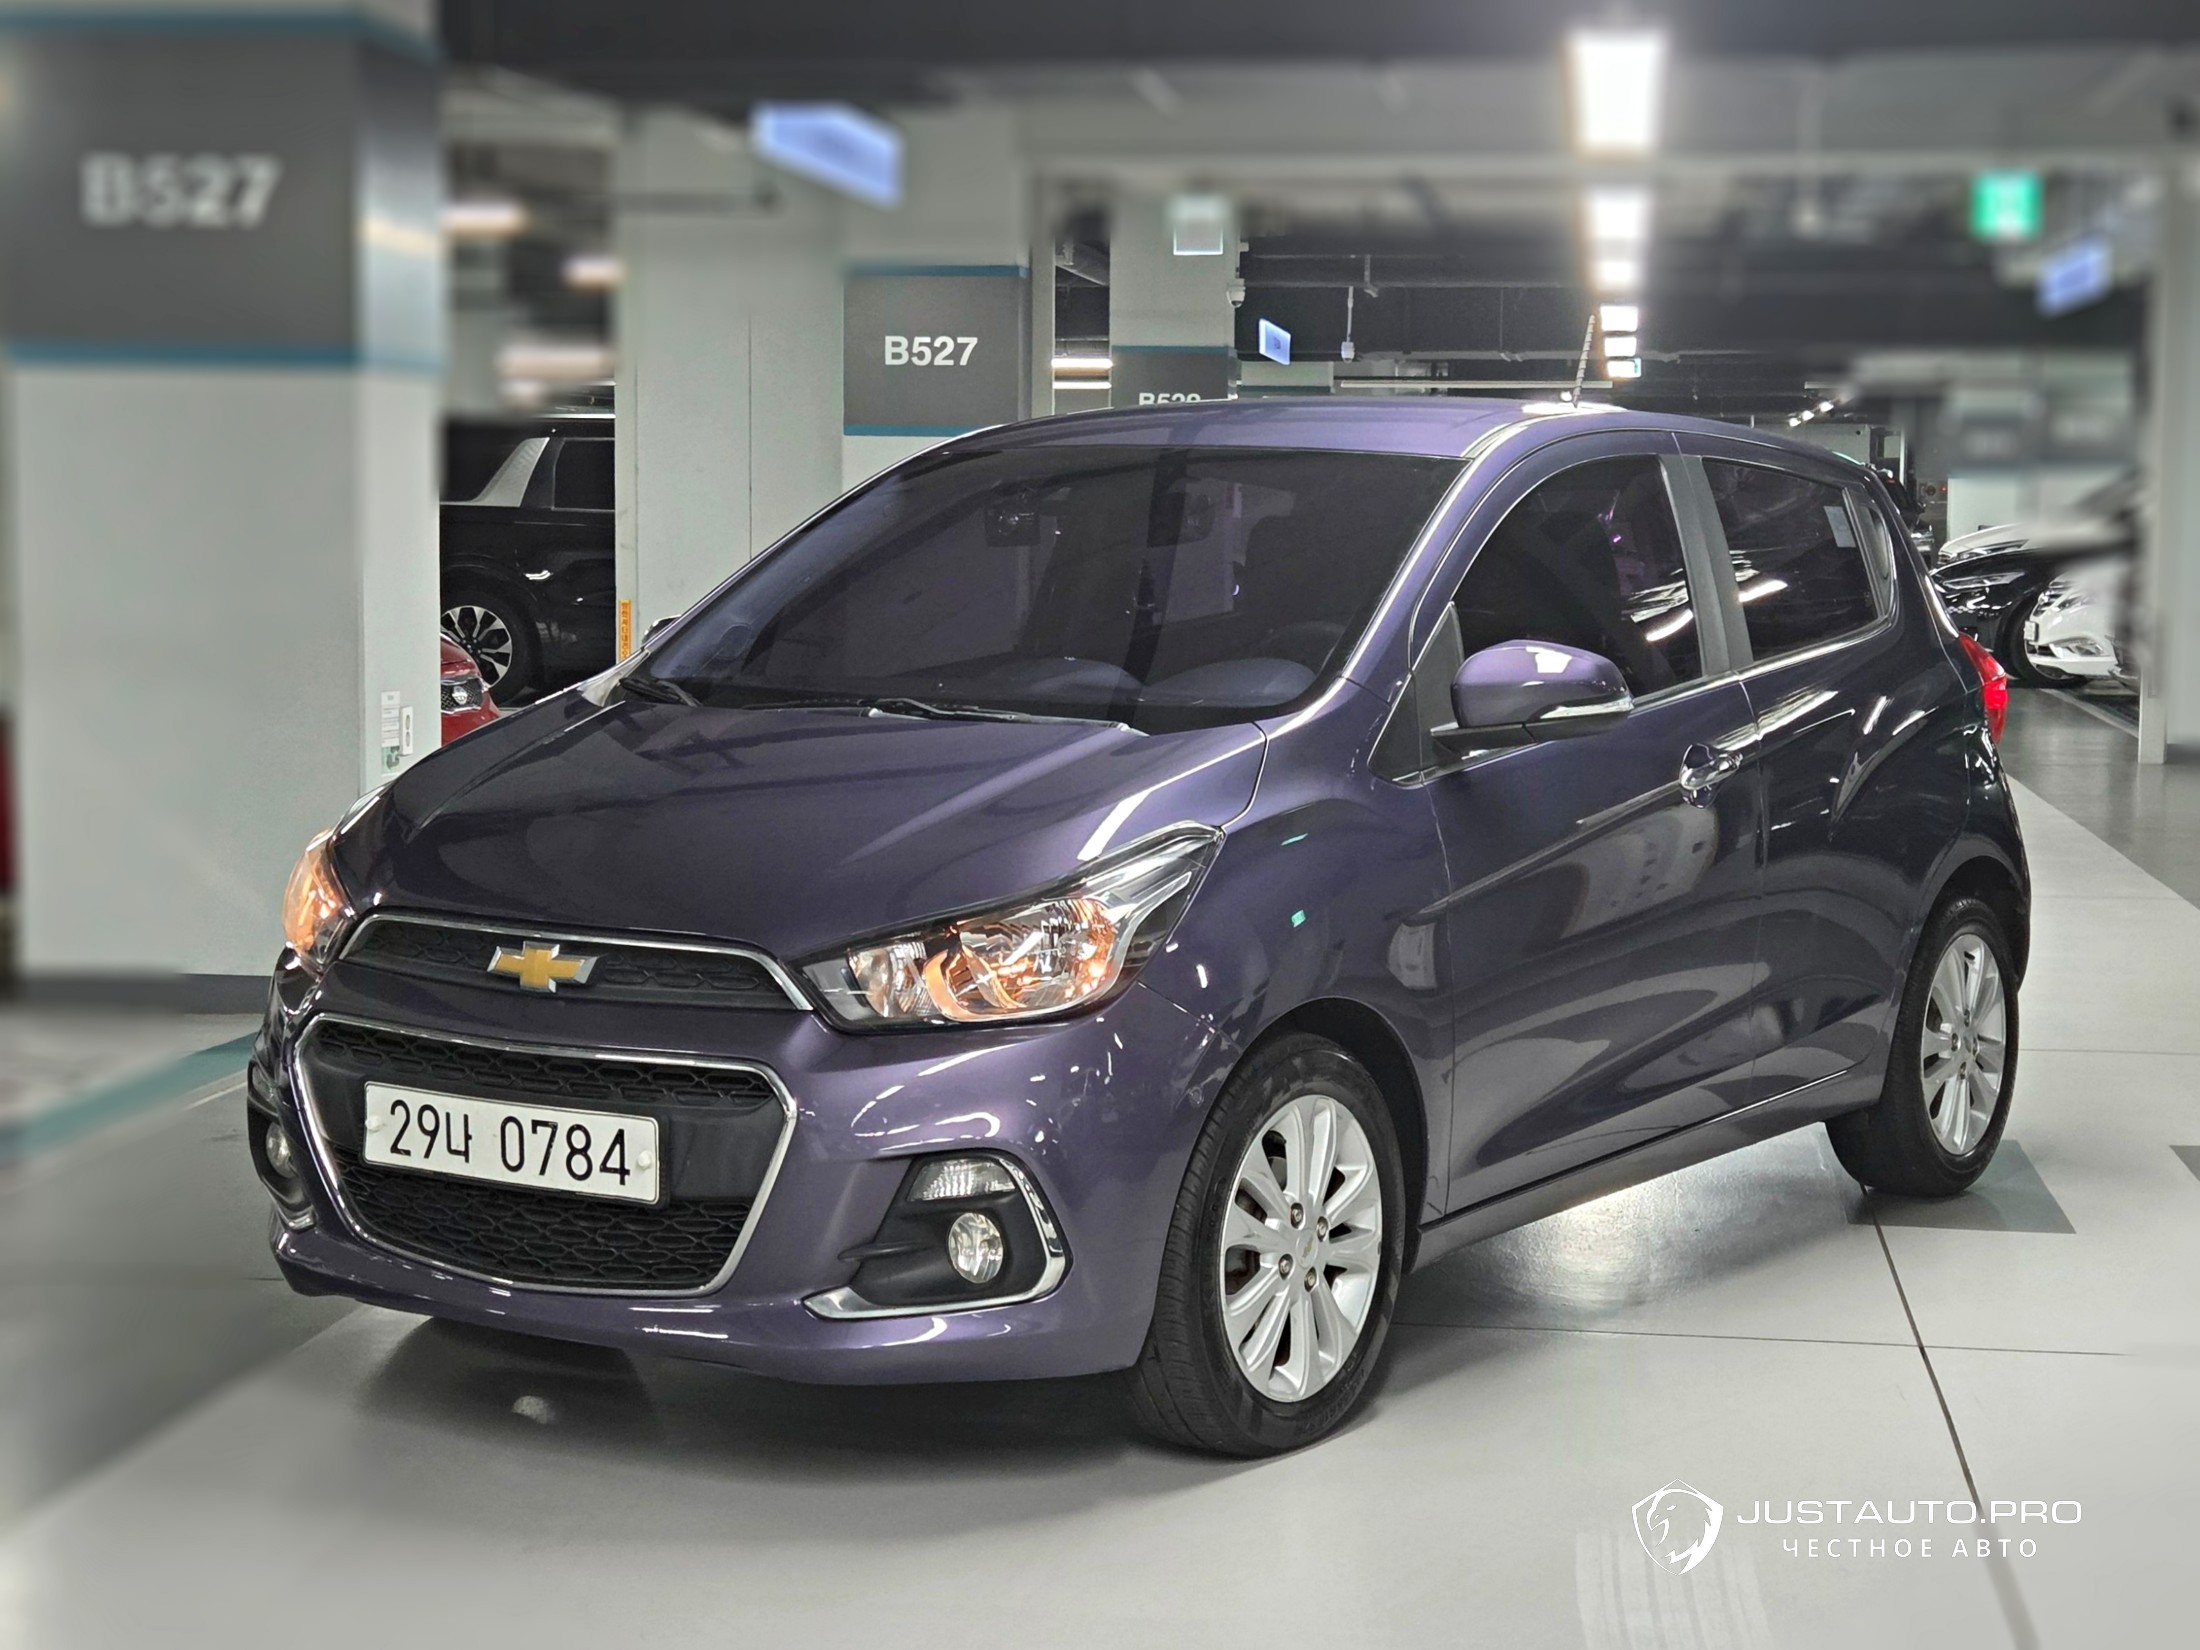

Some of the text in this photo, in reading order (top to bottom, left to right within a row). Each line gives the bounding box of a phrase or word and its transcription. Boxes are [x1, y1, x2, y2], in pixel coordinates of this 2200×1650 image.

[82, 151, 281, 230] B527
[885, 335, 978, 366] B527
[390, 1099, 630, 1186] 29나 0784
